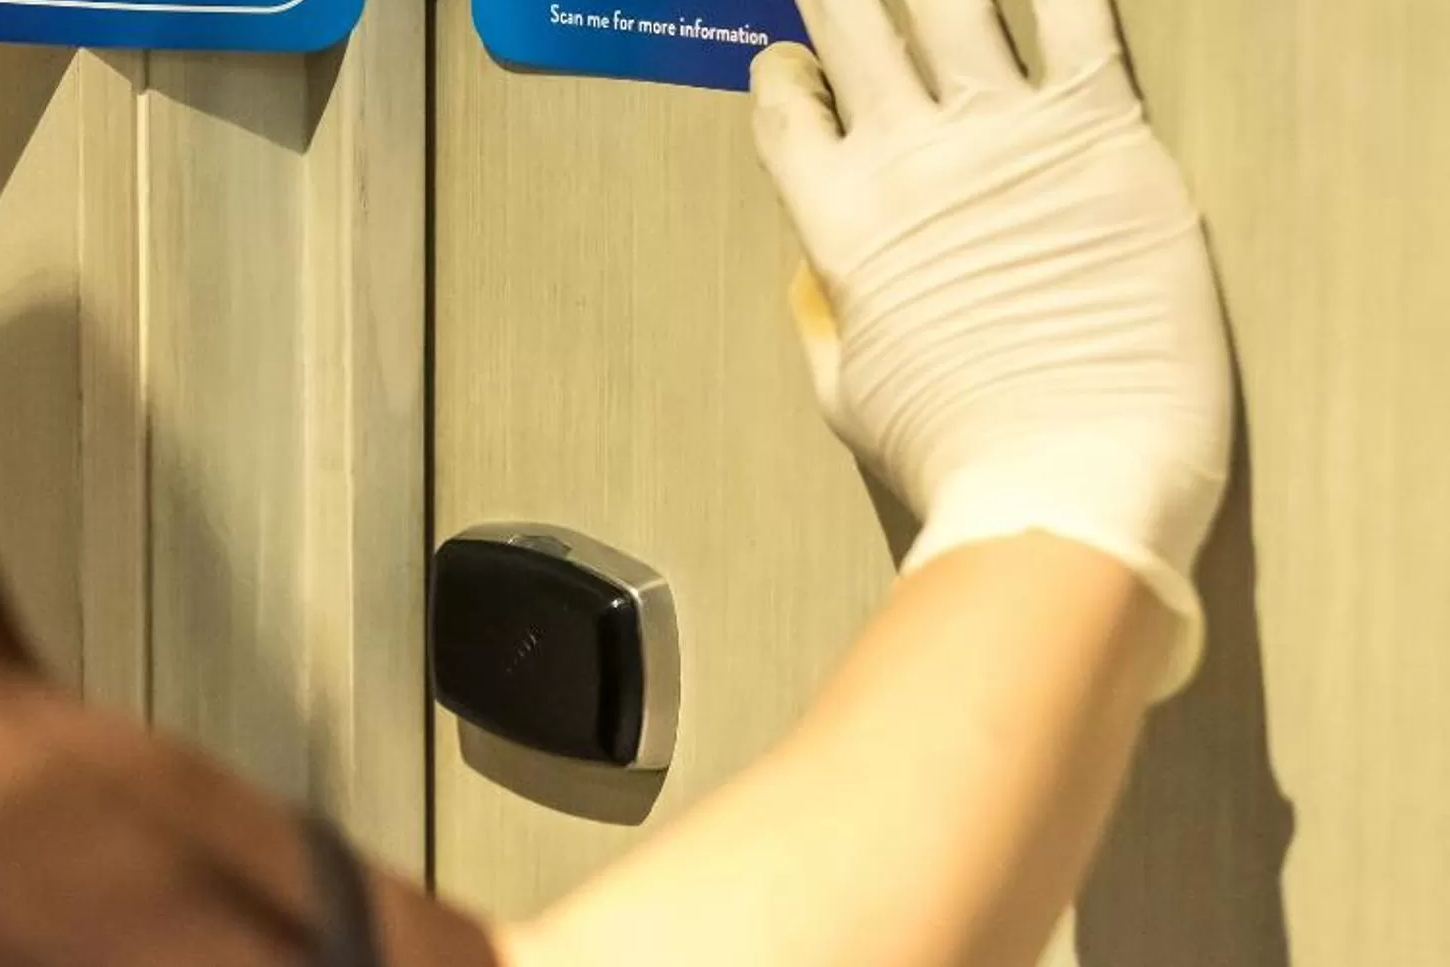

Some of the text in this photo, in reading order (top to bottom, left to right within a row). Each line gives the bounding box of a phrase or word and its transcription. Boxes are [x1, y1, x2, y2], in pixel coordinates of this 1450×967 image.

[550, 3, 769, 46] Scan me for more information
